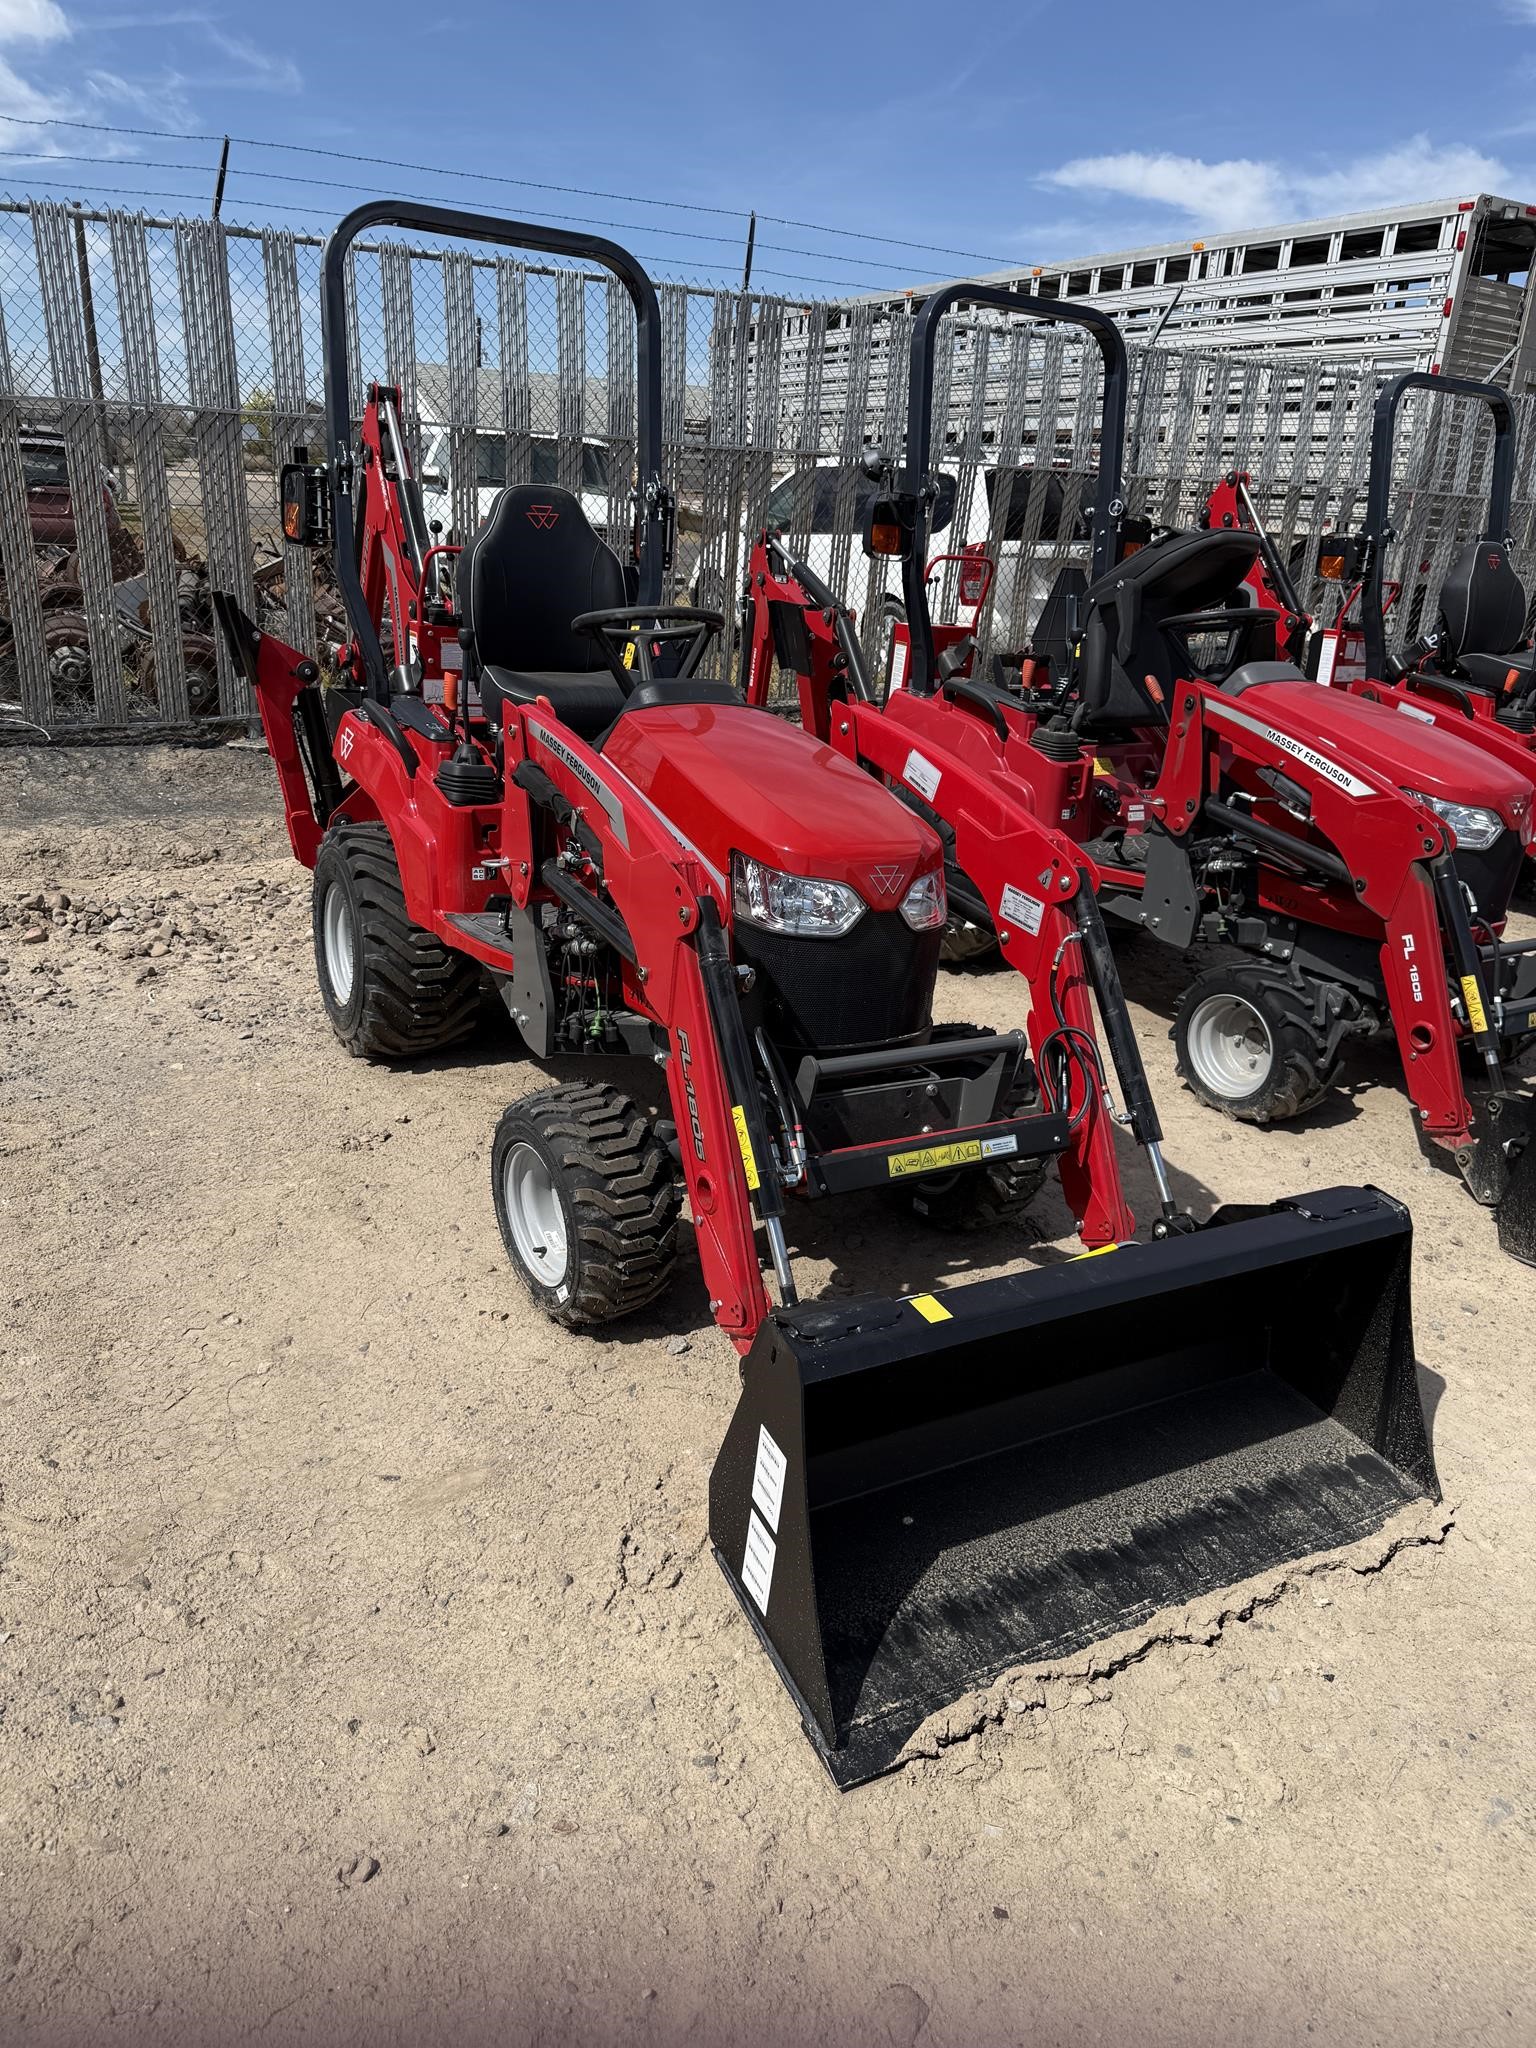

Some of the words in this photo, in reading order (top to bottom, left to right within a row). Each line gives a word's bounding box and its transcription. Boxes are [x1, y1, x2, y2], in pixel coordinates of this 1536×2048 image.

[540, 729, 566, 759] MASSEY
[565, 753, 601, 795] FERGUSON
[1266, 730, 1304, 755] MASSEY
[1303, 751, 1352, 788] FERGUSON
[1401, 933, 1416, 961] FL
[1409, 964, 1423, 1002] 1805
